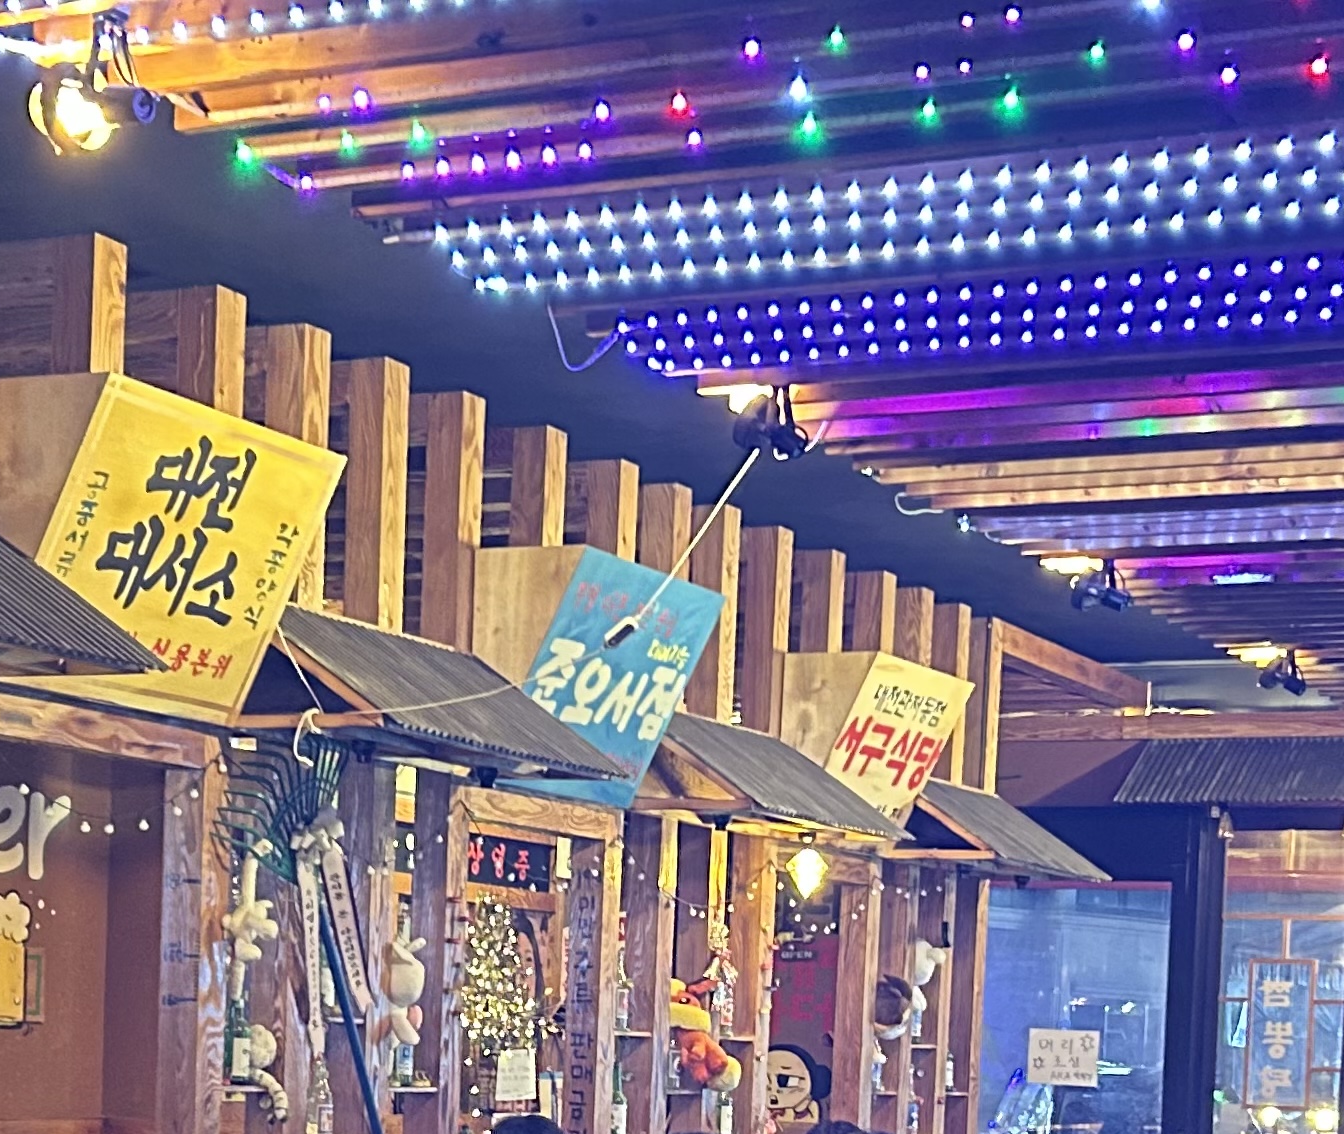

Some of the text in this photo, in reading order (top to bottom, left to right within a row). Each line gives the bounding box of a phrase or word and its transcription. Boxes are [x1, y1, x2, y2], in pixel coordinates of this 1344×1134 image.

[146, 435, 257, 533] 대전
[95, 514, 238, 627] 대서소
[532, 637, 686, 741] 준오서점
[834, 715, 943, 791] 서구식당
[468, 841, 531, 882] 상영중
